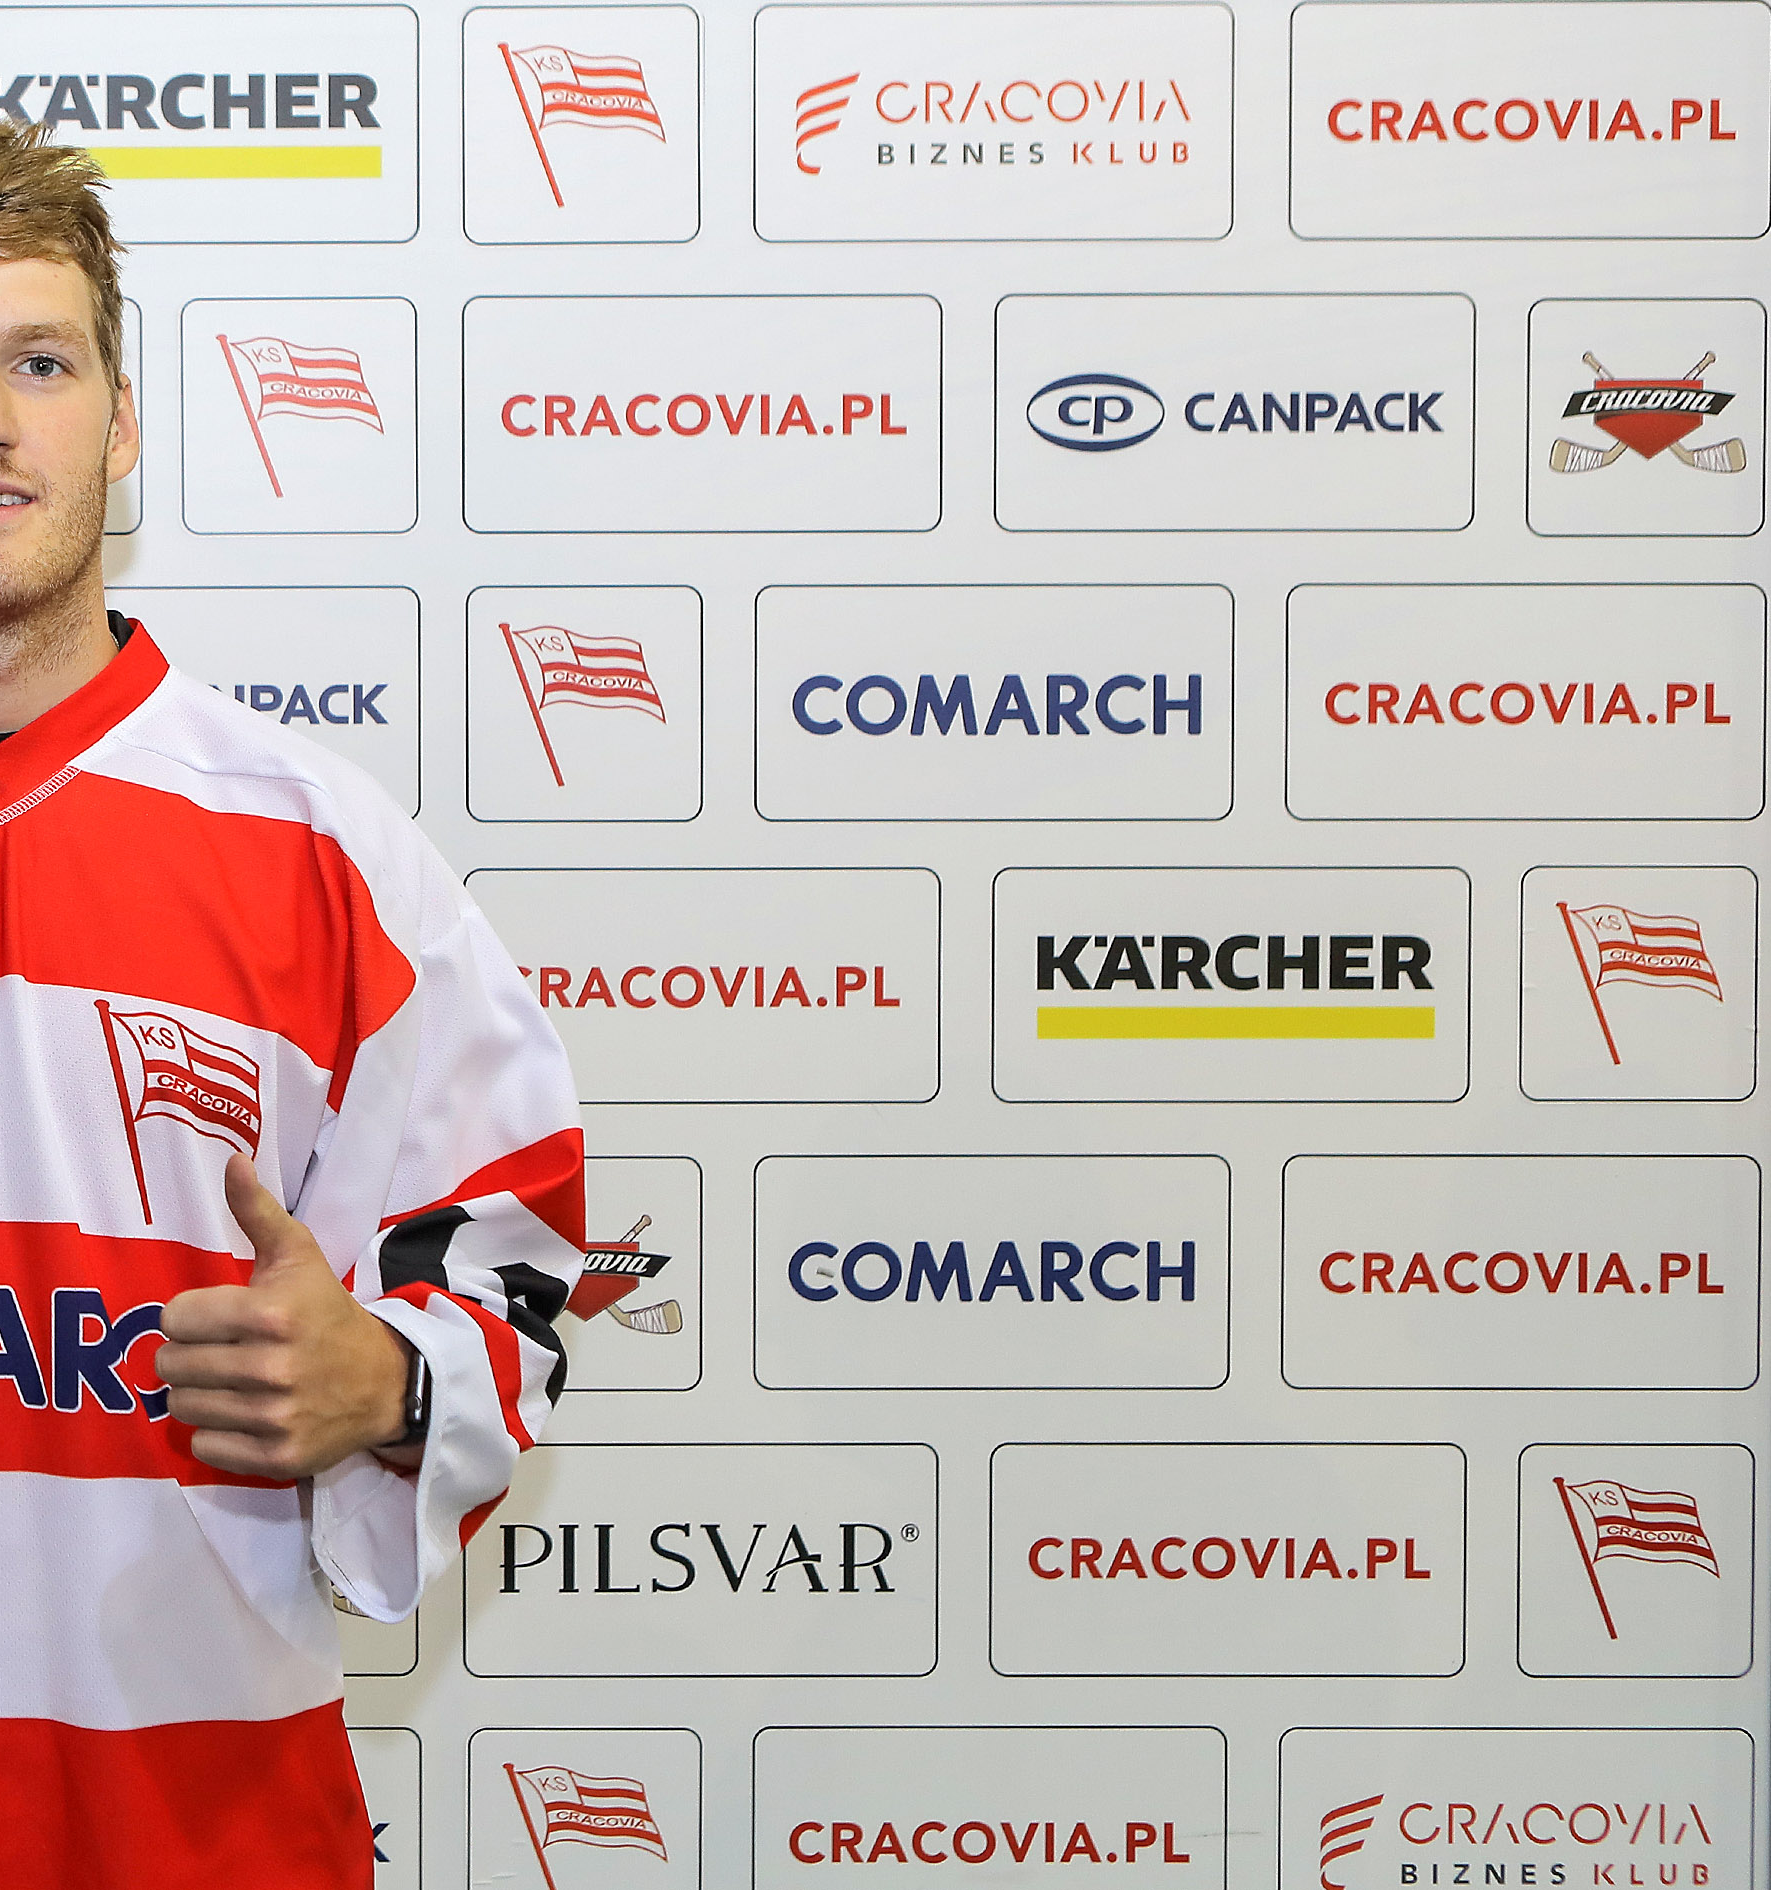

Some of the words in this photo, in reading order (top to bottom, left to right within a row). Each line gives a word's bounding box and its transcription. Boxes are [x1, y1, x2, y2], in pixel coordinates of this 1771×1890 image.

[533, 55, 566, 74] KS
[551, 89, 646, 110] CRACOVIA
[876, 80, 1190, 123] CRACOVIA
[1328, 99, 1737, 142] CRACOVIA.PL
[878, 143, 1045, 164] BIZNES
[1073, 142, 1189, 164] KLUB
[252, 345, 283, 364] KS
[268, 381, 362, 401] CRACOVIA
[501, 394, 908, 437] CRACOVIA.PL
[1185, 392, 1444, 433] CANPACK
[533, 636, 565, 654] KS
[550, 671, 646, 691] CRACOVIA
[792, 673, 1202, 736] COMARCH
[1324, 682, 1731, 725] CRACOVIA.PL
[1591, 914, 1622, 932] KS
[1037, 935, 1435, 991] KÄRCHER
[1609, 949, 1703, 971] CRACOVIA
[517, 966, 901, 1008] RACOVIA.PL
[139, 1025, 176, 1050] KS
[157, 1074, 252, 1126] CRACOVIA
[788, 1241, 1196, 1302] COMARCH
[1319, 1252, 1725, 1294] CRACOVIA.PL
[1588, 1491, 1619, 1508] KS
[1606, 1525, 1700, 1546] CRACOVIA
[1028, 1537, 1431, 1580] CRACOVIA.PL
[538, 1776, 569, 1794] KS
[555, 1809, 648, 1831] CRACOVIA
[1400, 1803, 1712, 1844] CRACOVIA
[788, 1821, 1191, 1864] CRACOVIA.PL
[1401, 1864, 1566, 1886] BIZNES
[1594, 1864, 1709, 1886] KLUB
